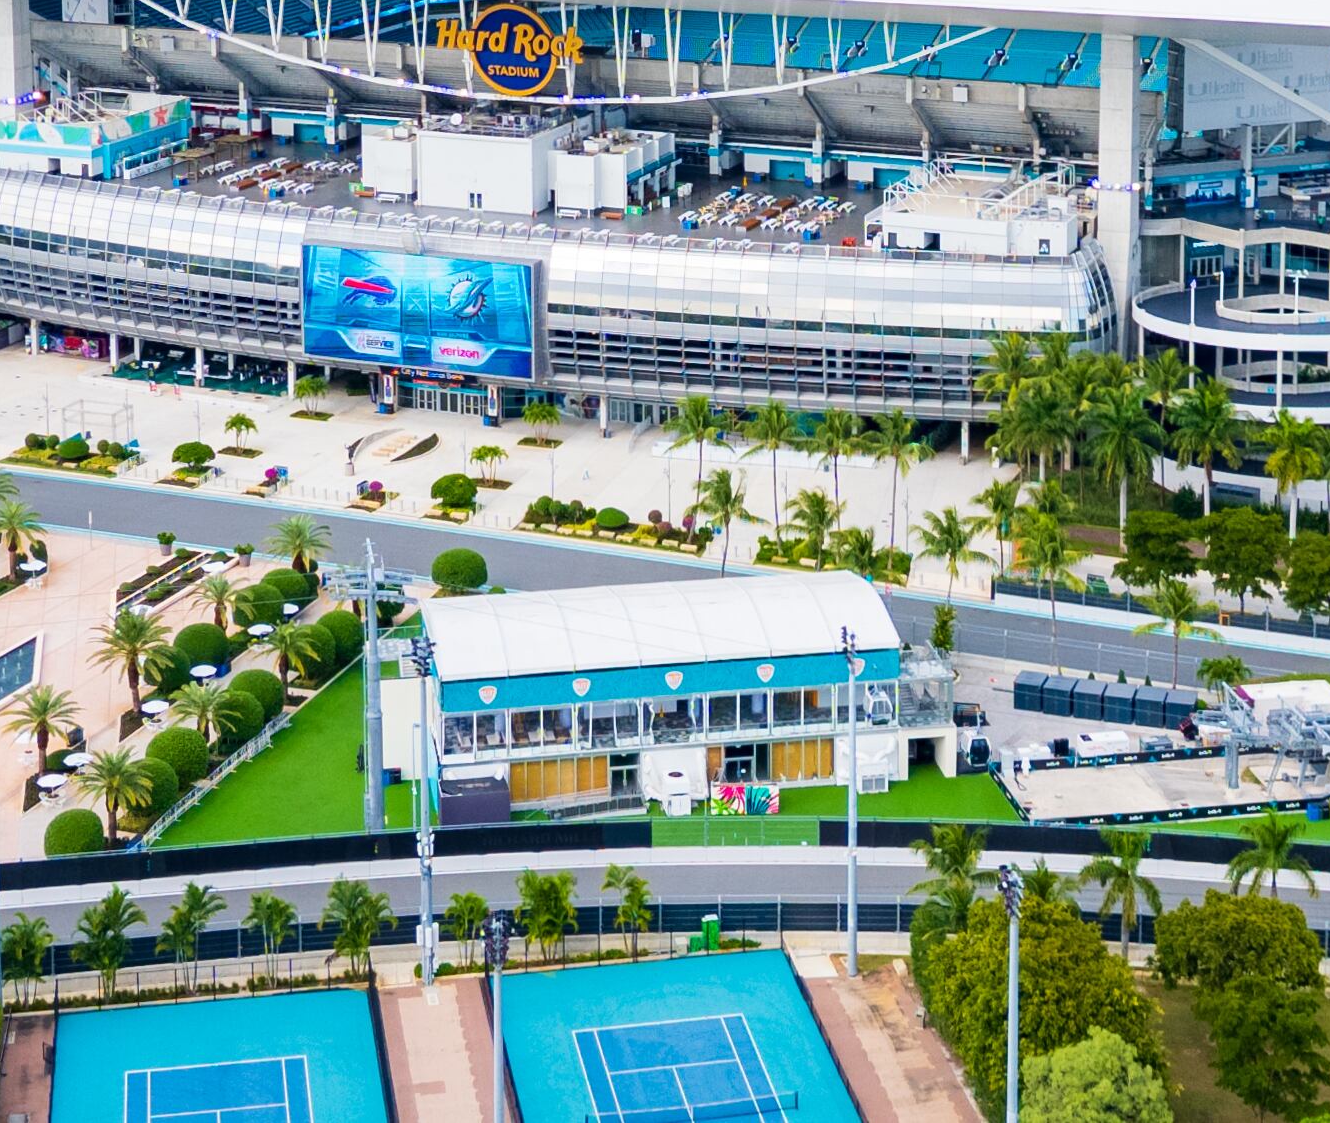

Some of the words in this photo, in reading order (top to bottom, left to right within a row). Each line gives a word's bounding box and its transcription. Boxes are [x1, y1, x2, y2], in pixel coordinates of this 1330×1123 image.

[436, 19, 509, 53] Hard
[513, 23, 584, 64] Rock
[487, 64, 540, 78] STADIUM
[439, 345, 480, 359] verizon
